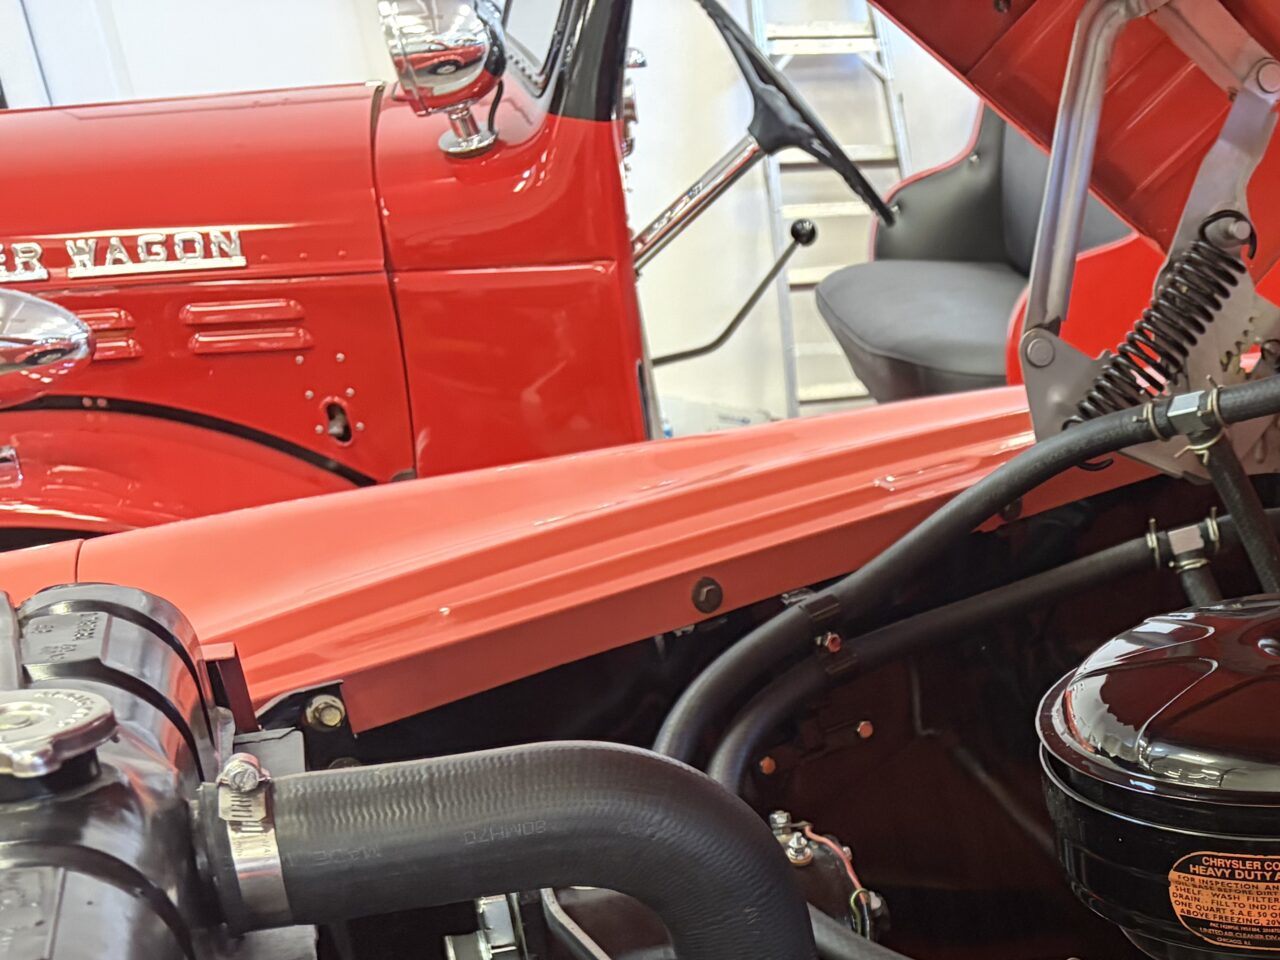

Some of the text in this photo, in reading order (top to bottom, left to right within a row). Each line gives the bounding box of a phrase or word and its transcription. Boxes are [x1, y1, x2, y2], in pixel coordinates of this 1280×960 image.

[65, 229, 243, 275] WAGON
[1202, 856, 1261, 870] CHRYSLER
[1189, 864, 1232, 879] HEAVY
[1235, 869, 1273, 881] DUTY
[1177, 874, 1195, 883] FOR
[1198, 878, 1259, 890] INSPECTION
[1211, 892, 1241, 901] WASH
[1246, 895, 1280, 903] FILTER
[1217, 887, 1254, 896] BEFORE
[1174, 899, 1193, 909] ONE
[1195, 904, 1226, 914] QUART
[1211, 899, 1230, 908] FILL
[1233, 901, 1246, 909] TO
[1180, 908, 1211, 920] ABOVE
